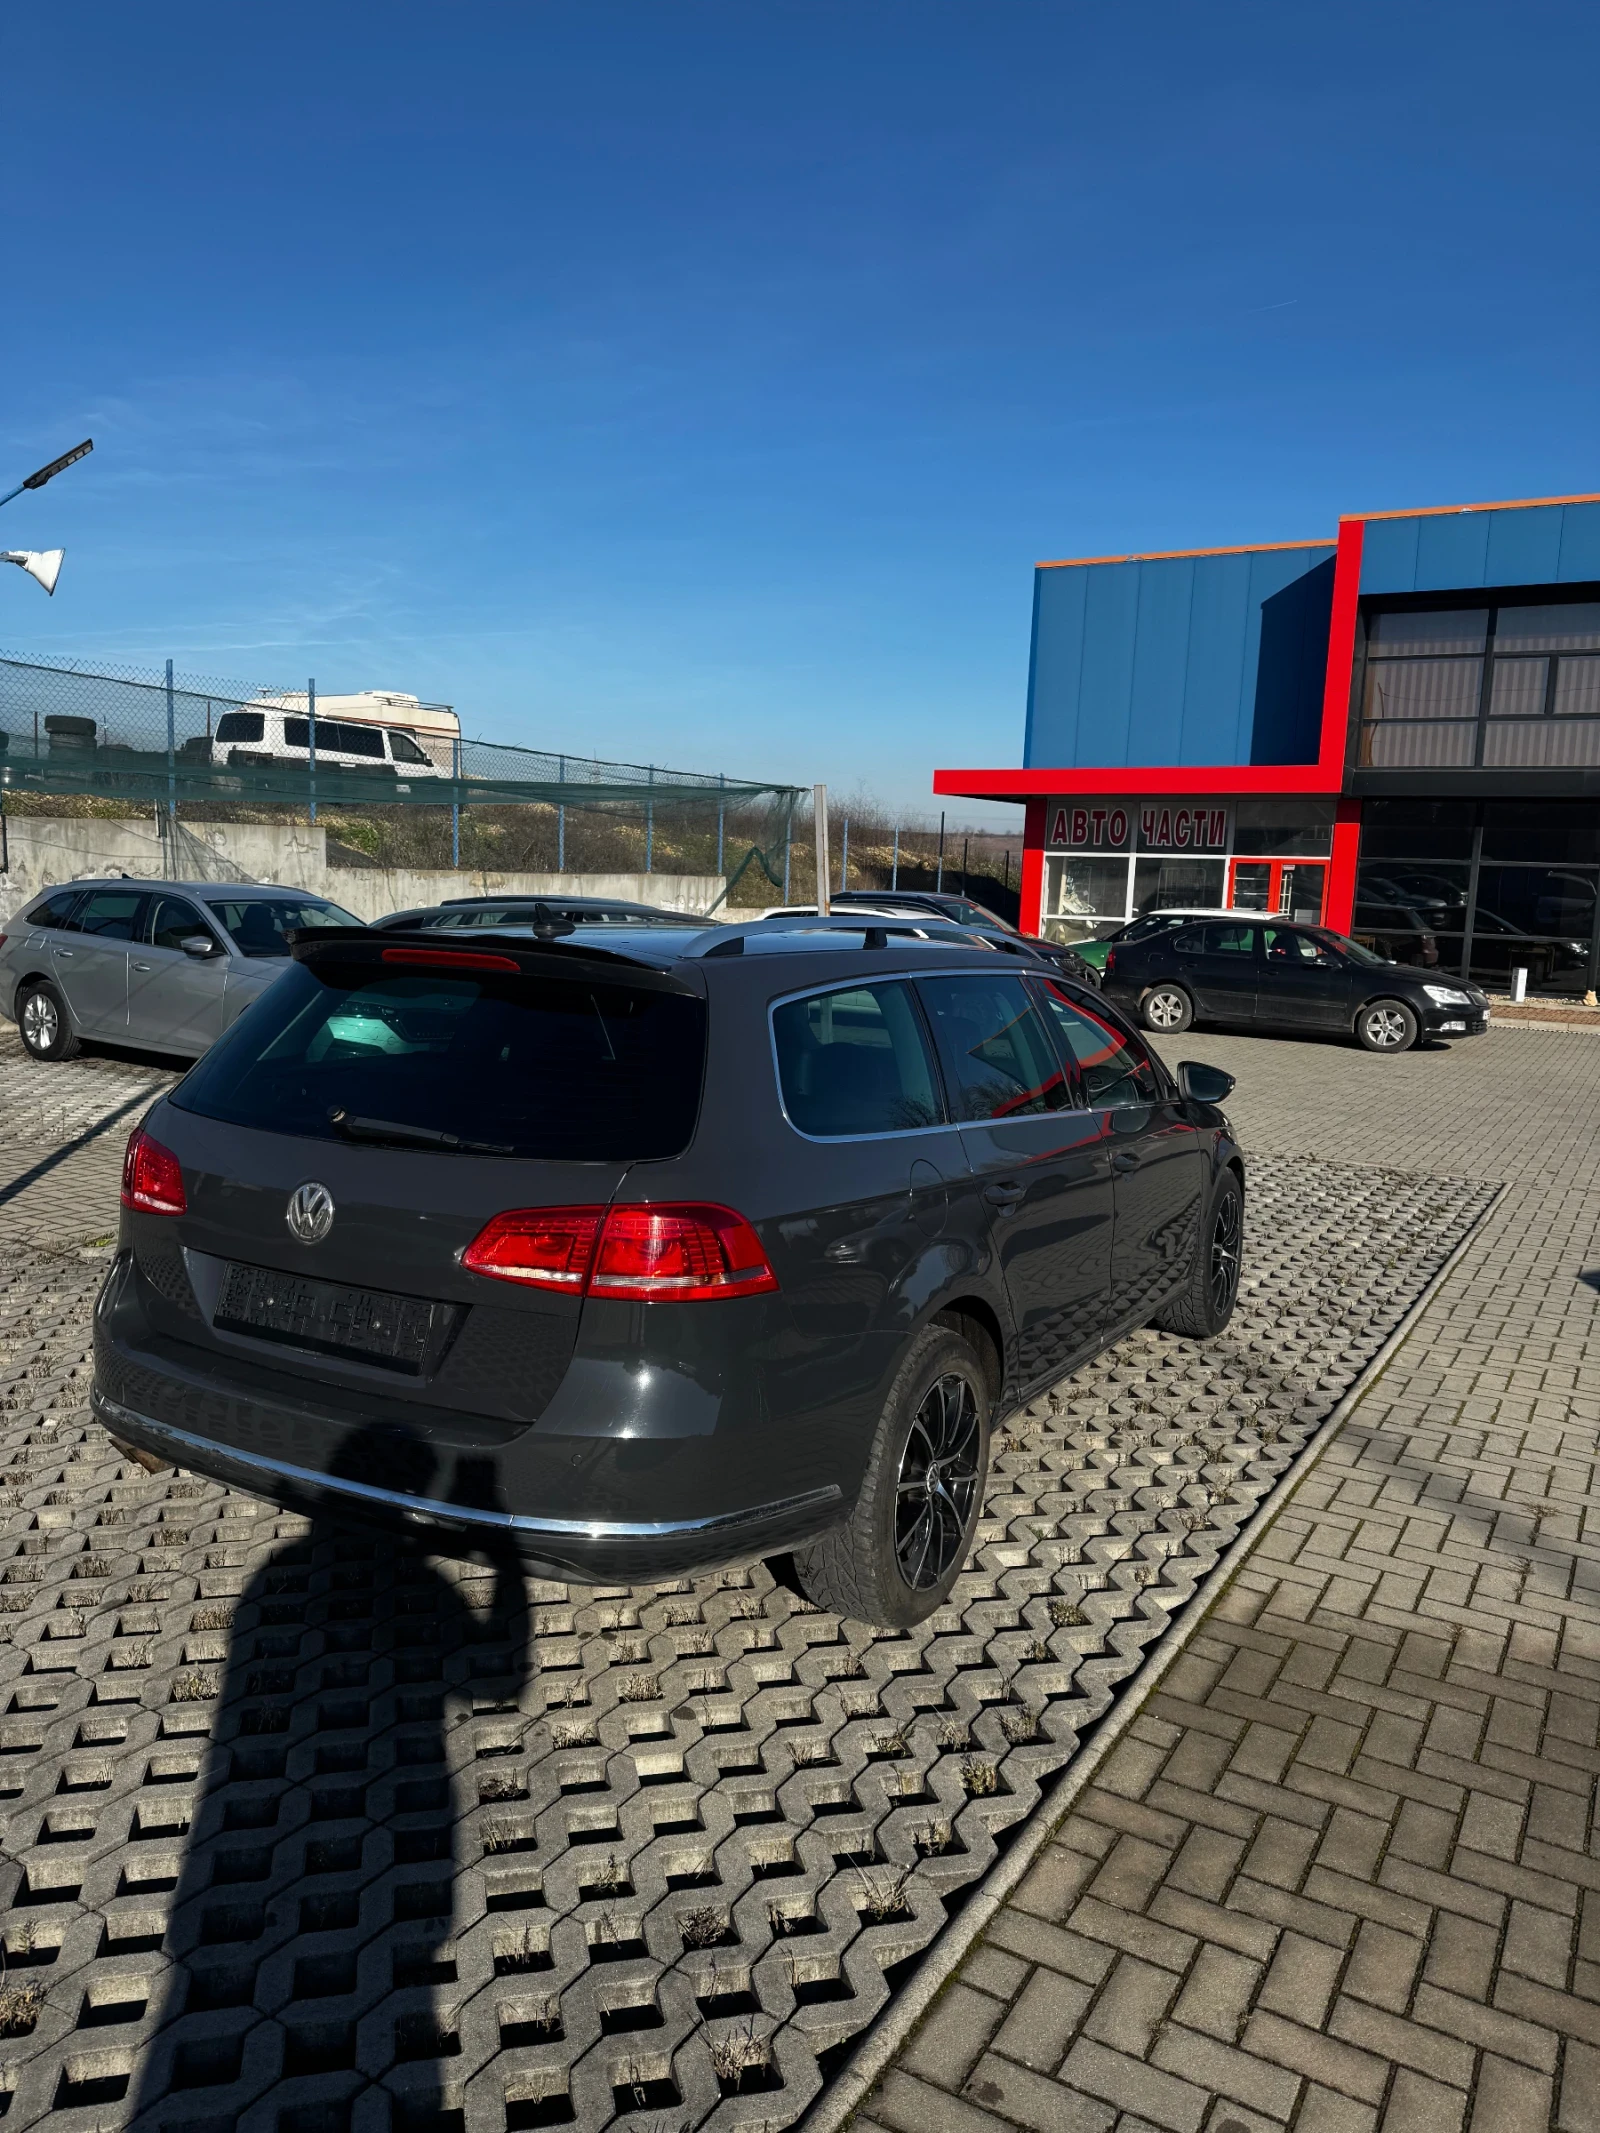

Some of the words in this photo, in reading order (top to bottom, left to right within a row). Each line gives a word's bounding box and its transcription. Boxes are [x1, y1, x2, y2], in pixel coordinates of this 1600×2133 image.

[1050, 808, 1129, 846] АВТО
[1141, 808, 1227, 848] ЧАСТИ
[288, 1183, 335, 1243] VW
